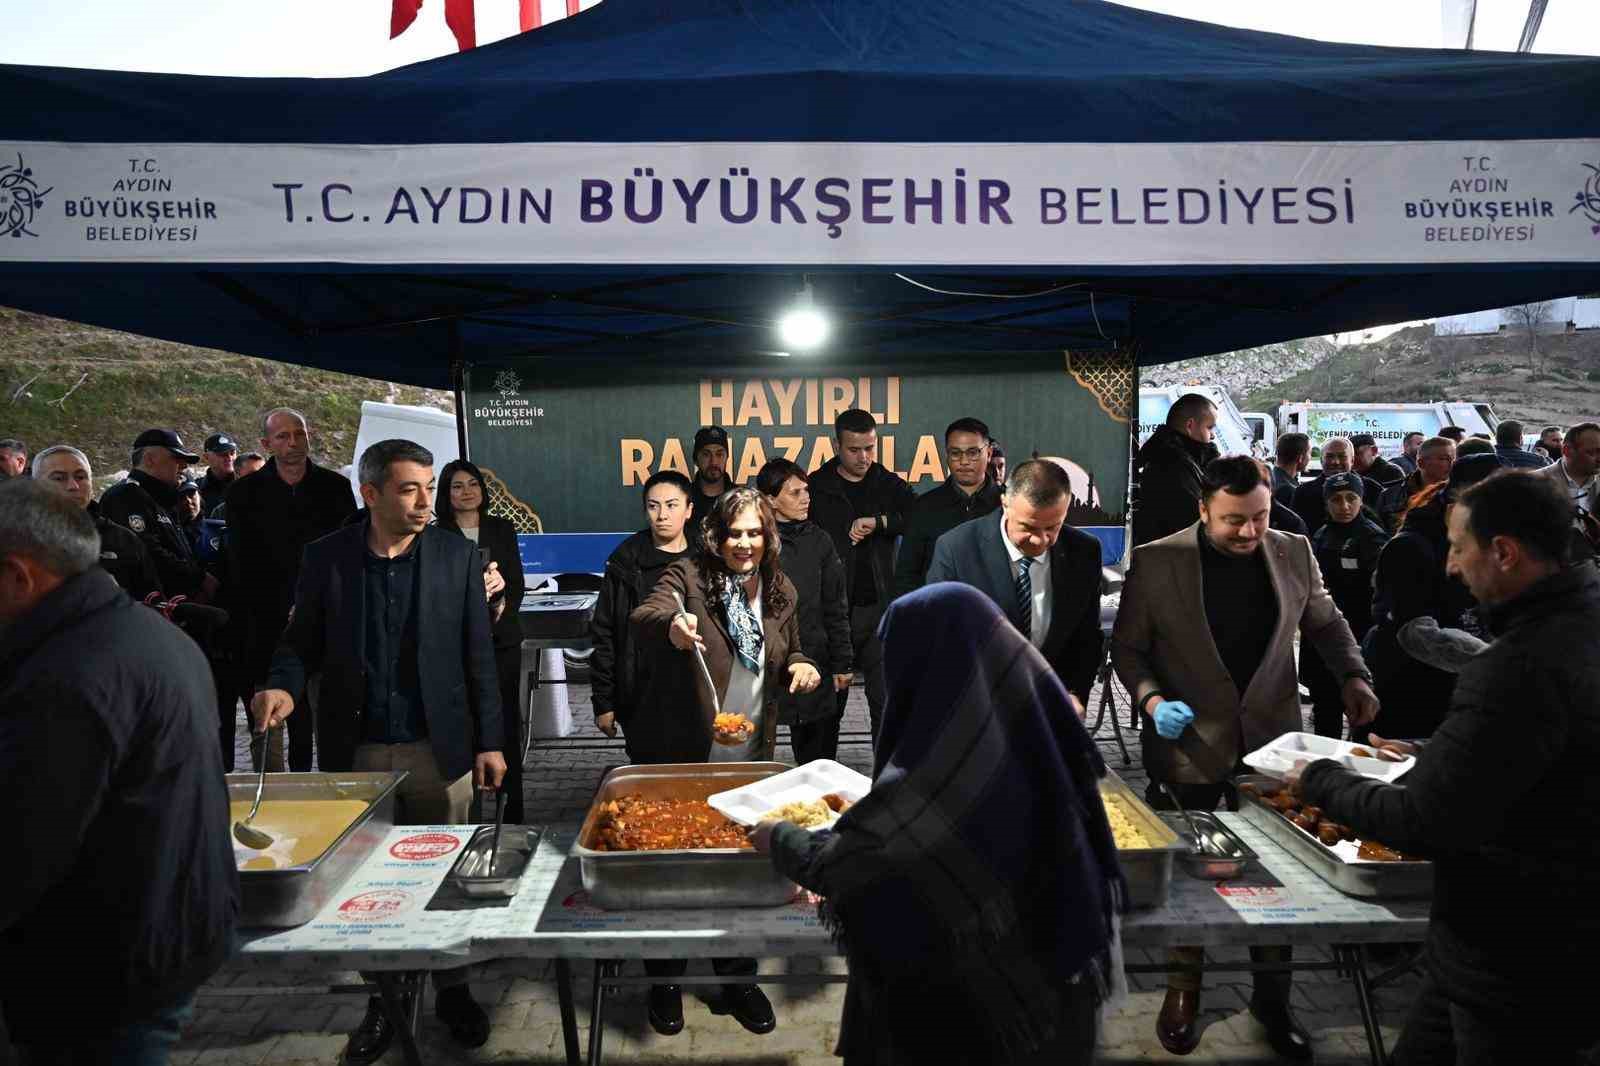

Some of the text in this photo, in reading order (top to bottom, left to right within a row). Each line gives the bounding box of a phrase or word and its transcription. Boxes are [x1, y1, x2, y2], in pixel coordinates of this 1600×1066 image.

[129, 159, 160, 173] T.C.
[1463, 157, 1496, 172] T.C.
[112, 178, 172, 192] AYDIN
[1449, 178, 1508, 193] AYDIN
[64, 197, 217, 223] BÜYÜKŞEHİR
[272, 167, 1355, 239] T.C. AYDIN BÜYÜKŞEHİR BELEDİYESİ
[1404, 198, 1554, 222] BÜYÜKŞEHİR
[86, 225, 198, 242] BELEDİYESİ
[1425, 224, 1535, 242] BELEDİYESİ
[700, 376, 901, 426] HAYIRLI
[474, 406, 544, 419] BÜYÜKŞEHİR
